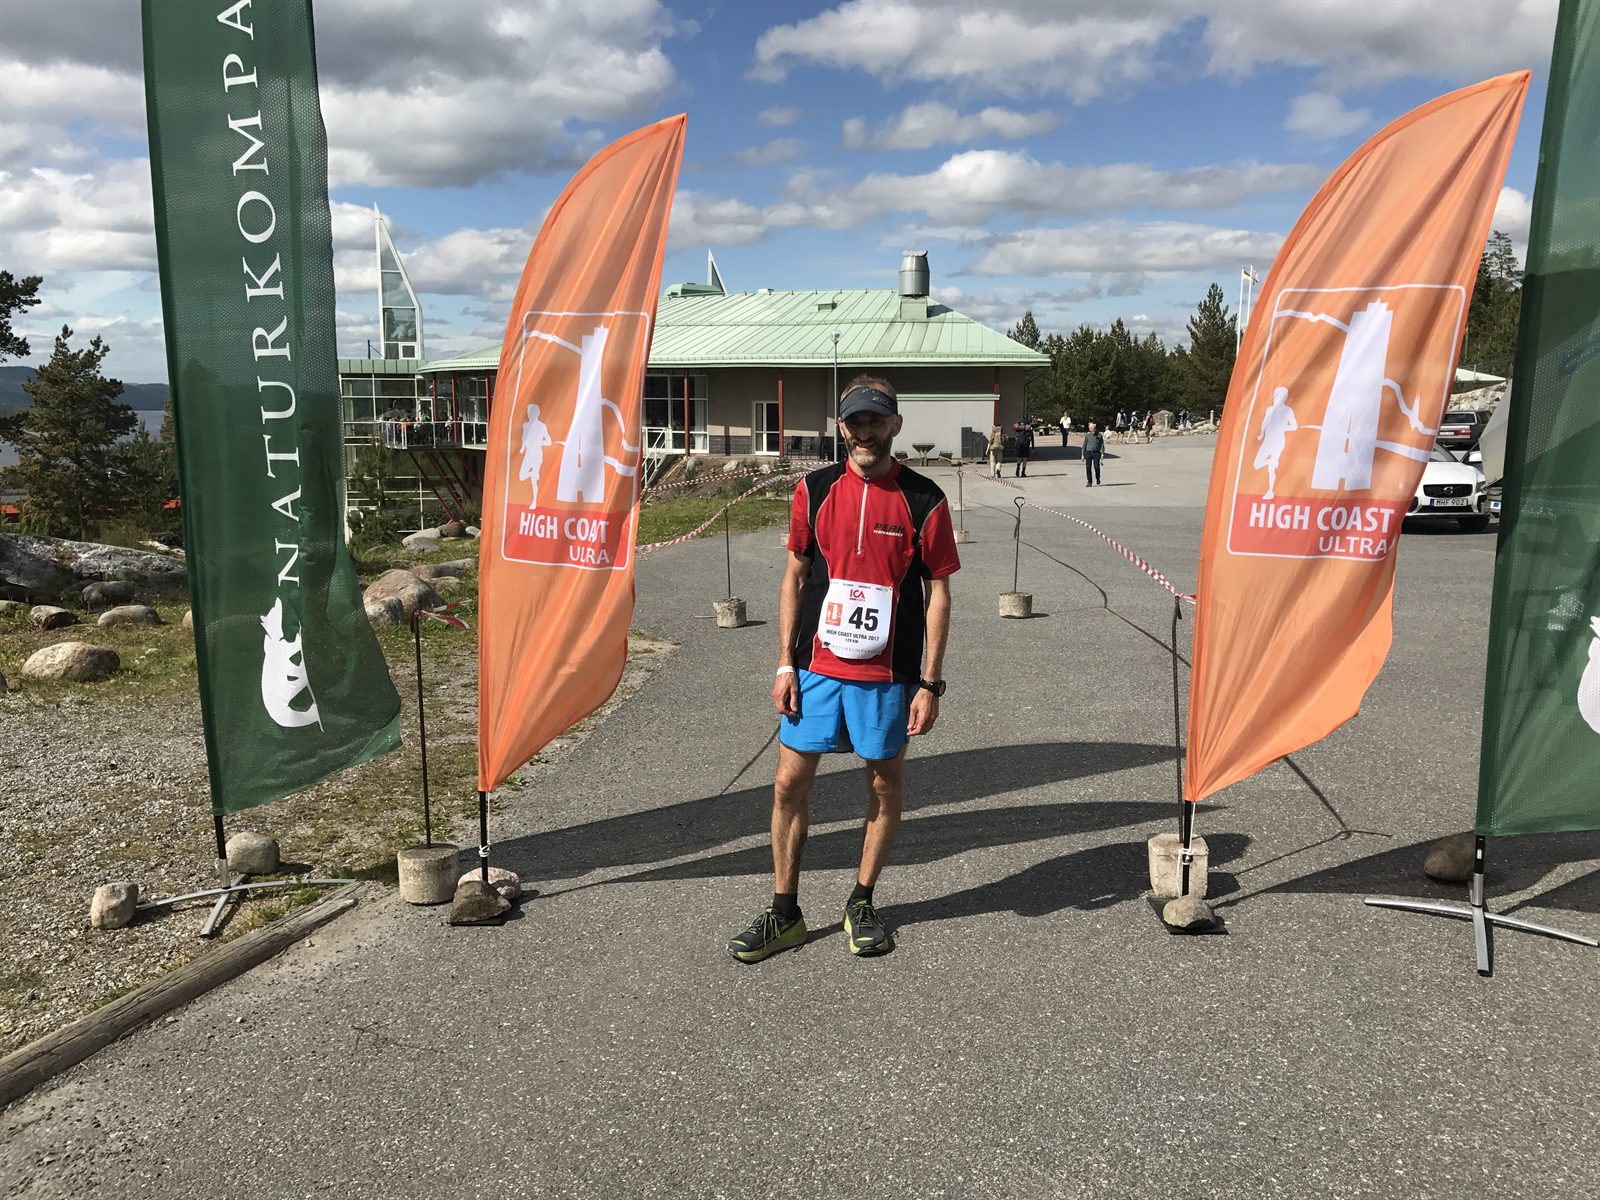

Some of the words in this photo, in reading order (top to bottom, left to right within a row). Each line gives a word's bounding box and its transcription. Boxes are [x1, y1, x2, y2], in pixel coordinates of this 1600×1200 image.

[216, 0, 301, 588] NATURKOMPA
[519, 512, 558, 539] HIGH
[563, 518, 609, 544] COAT
[1249, 503, 1310, 530] HIGH
[1316, 506, 1394, 533] COAST
[1319, 536, 1388, 555] ULTRA
[849, 589, 866, 599] ICA
[848, 606, 879, 632] 45
